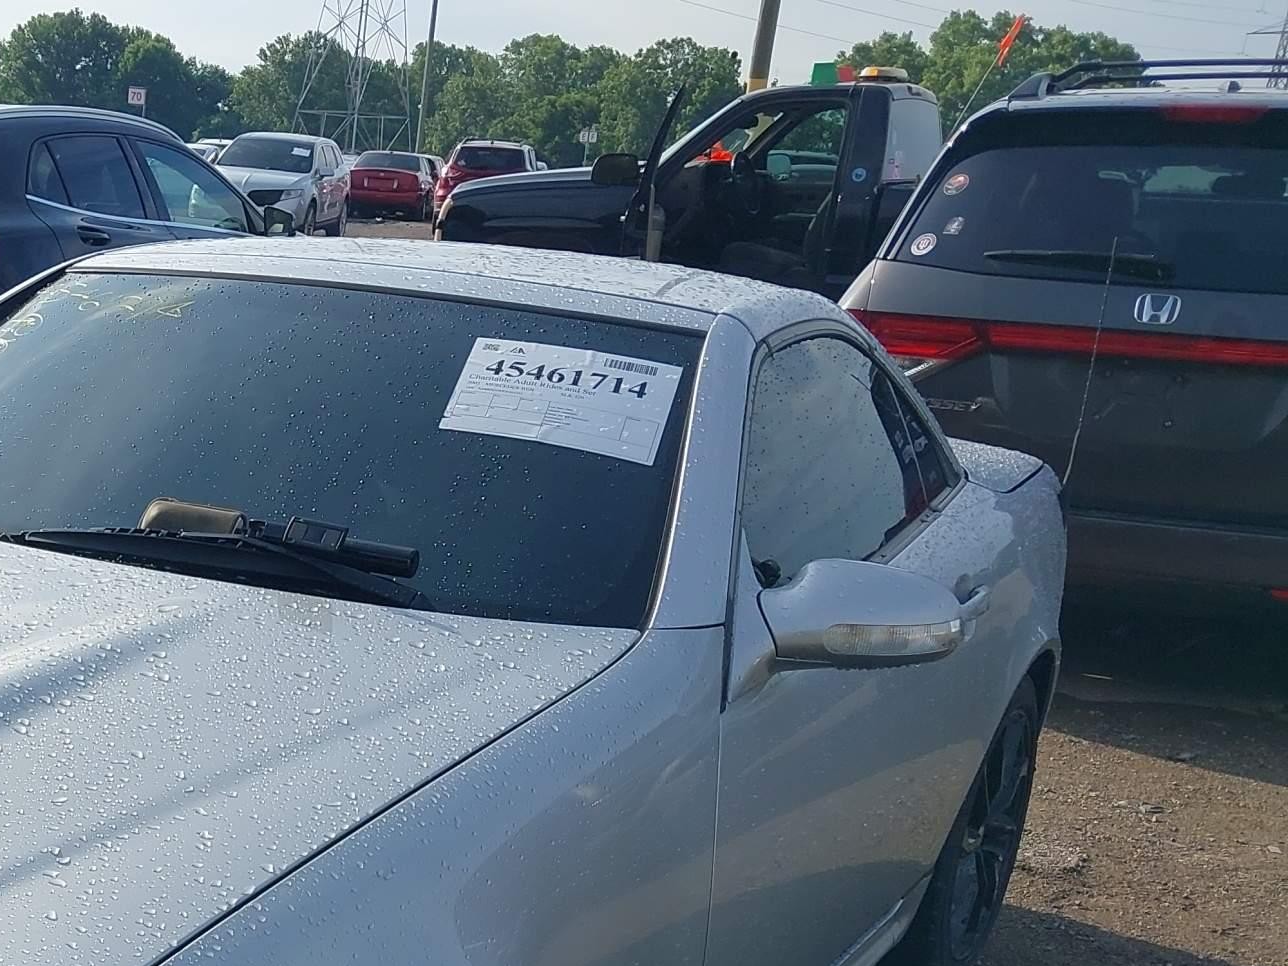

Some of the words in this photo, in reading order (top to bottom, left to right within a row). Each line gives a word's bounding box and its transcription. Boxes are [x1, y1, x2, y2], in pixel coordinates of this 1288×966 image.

[130, 91, 142, 102] 70
[469, 373, 511, 384] Charitable
[514, 378, 538, 387] Adult
[540, 381, 563, 391] Rides
[563, 386, 581, 394] and
[485, 359, 648, 399] 45461714
